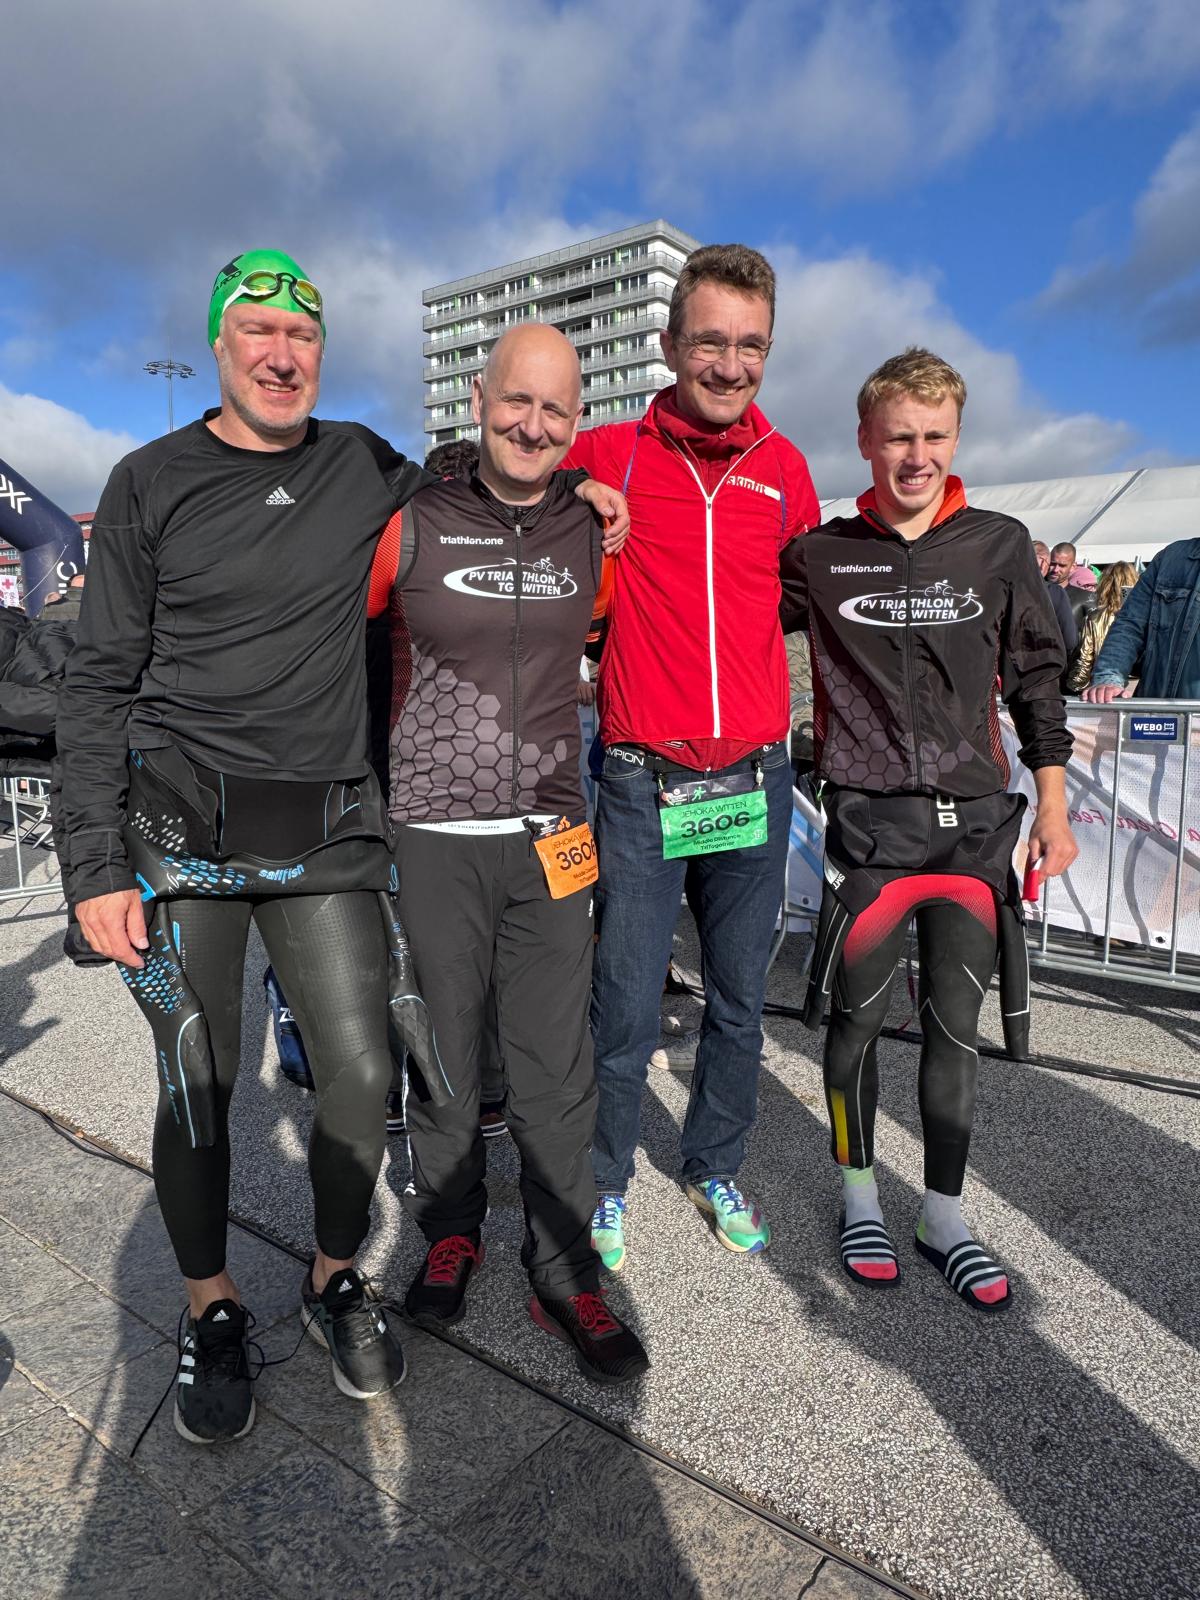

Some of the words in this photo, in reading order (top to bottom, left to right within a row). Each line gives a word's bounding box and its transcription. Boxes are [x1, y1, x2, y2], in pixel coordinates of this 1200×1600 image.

[440, 535, 504, 545] triathlon.one
[830, 564, 893, 574] triathlon.one
[468, 571, 486, 581] PV
[487, 571, 556, 585] TRIATHLON
[498, 582, 515, 593] TG
[521, 584, 561, 595] WITTEN
[860, 599, 878, 610] PV
[879, 598, 954, 610] TRIATHLON
[889, 610, 907, 621] TG
[911, 609, 959, 620] WITTEN
[1133, 723, 1163, 731] WEBO
[715, 801, 748, 814] WITTEN
[680, 811, 751, 839] 3606
[258, 864, 305, 885] sailfish
